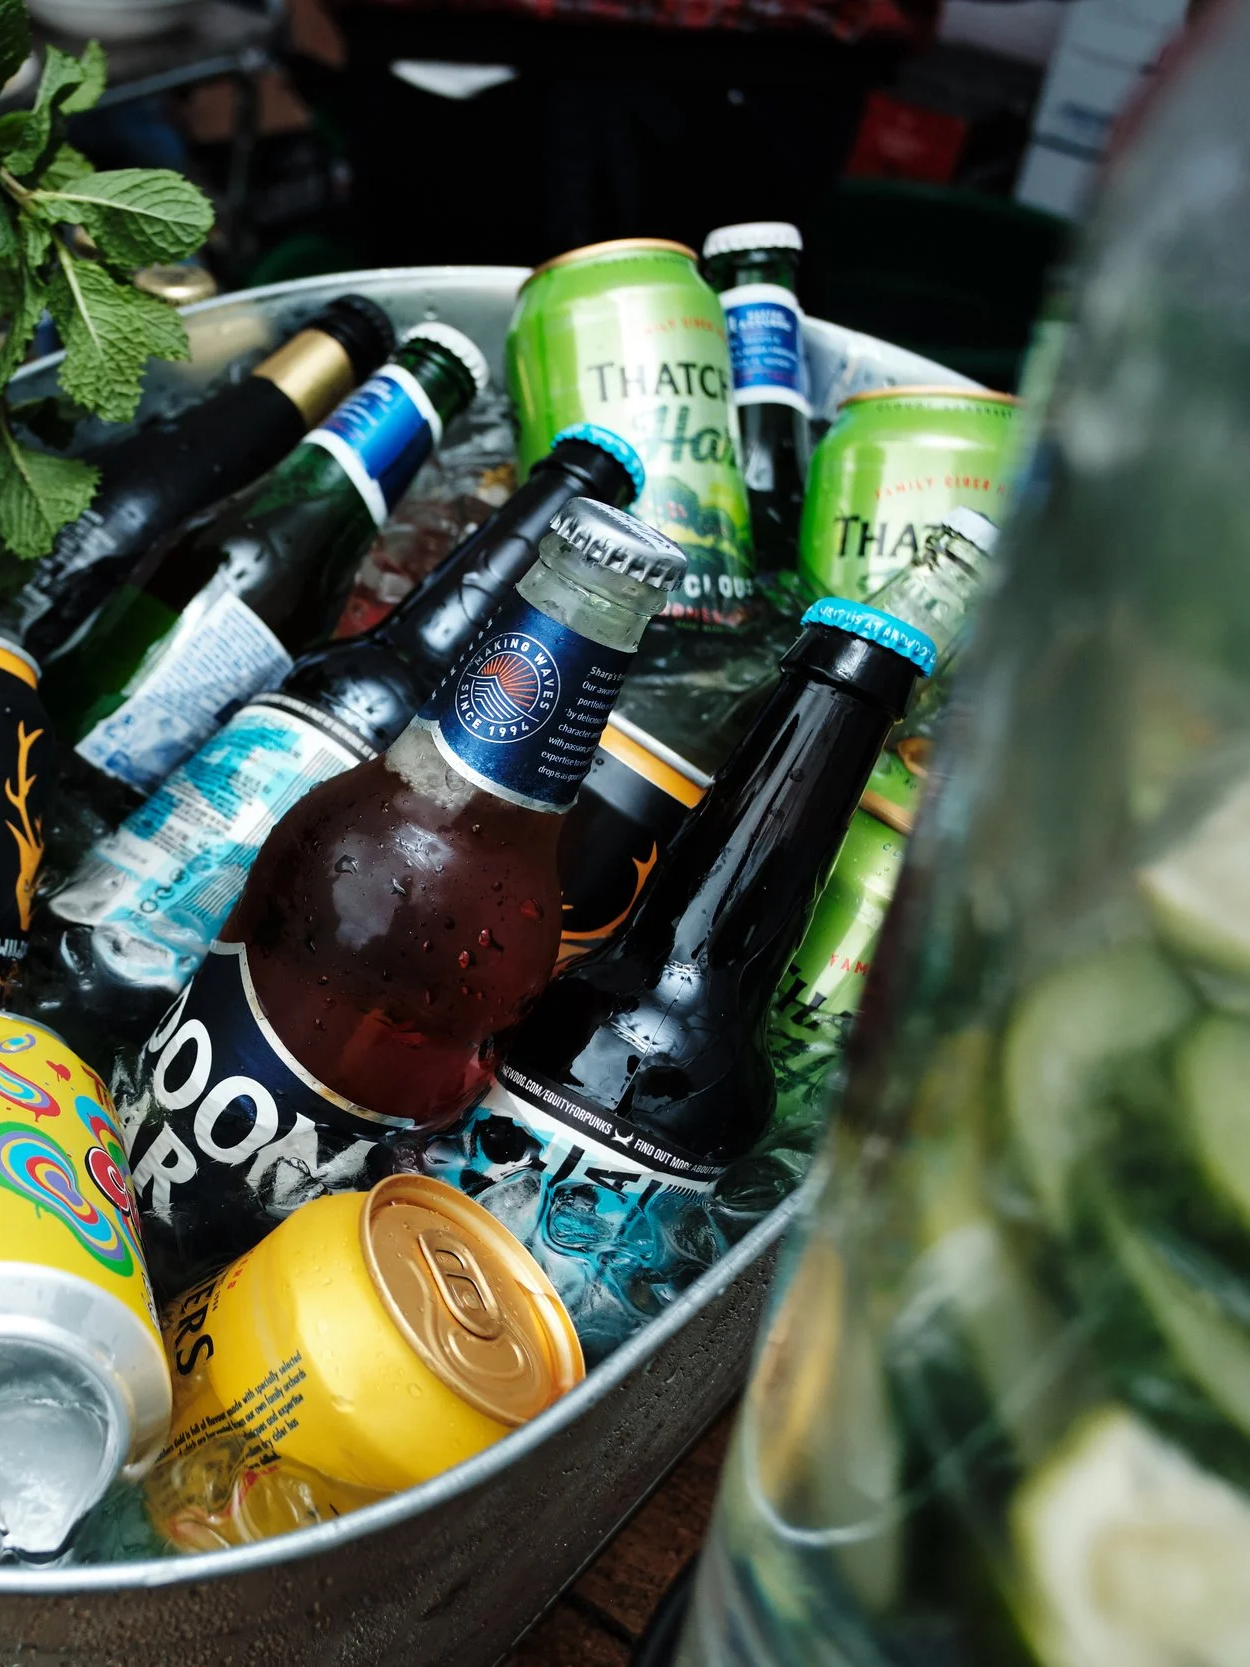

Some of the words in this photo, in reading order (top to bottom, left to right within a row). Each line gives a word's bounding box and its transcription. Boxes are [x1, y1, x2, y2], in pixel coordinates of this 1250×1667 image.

[874, 475, 934, 501] FAMILY
[474, 639, 530, 668] MAKING
[534, 653, 554, 711] WAVES
[590, 666, 617, 681] Sharp's
[582, 681, 598, 692] Our
[460, 684, 482, 731] SINCE
[566, 710, 577, 720] by
[548, 736, 565, 748] with
[558, 724, 591, 738] character
[541, 751, 574, 766] expertise
[538, 766, 555, 778] drop
[634, 1139, 655, 1156] FIND
[653, 1148, 673, 1164] OUT
[226, 1399, 243, 1417] made
[242, 1387, 256, 1404] with
[254, 1370, 280, 1395] specially
[279, 1349, 302, 1375] selected
[245, 1410, 256, 1422] our
[254, 1401, 268, 1415] own
[264, 1384, 285, 1406] family
[283, 1366, 307, 1392] orchards
[266, 1408, 280, 1427] and
[277, 1393, 304, 1418] expertise
[271, 1425, 289, 1442] cider
[285, 1418, 300, 1431] has
